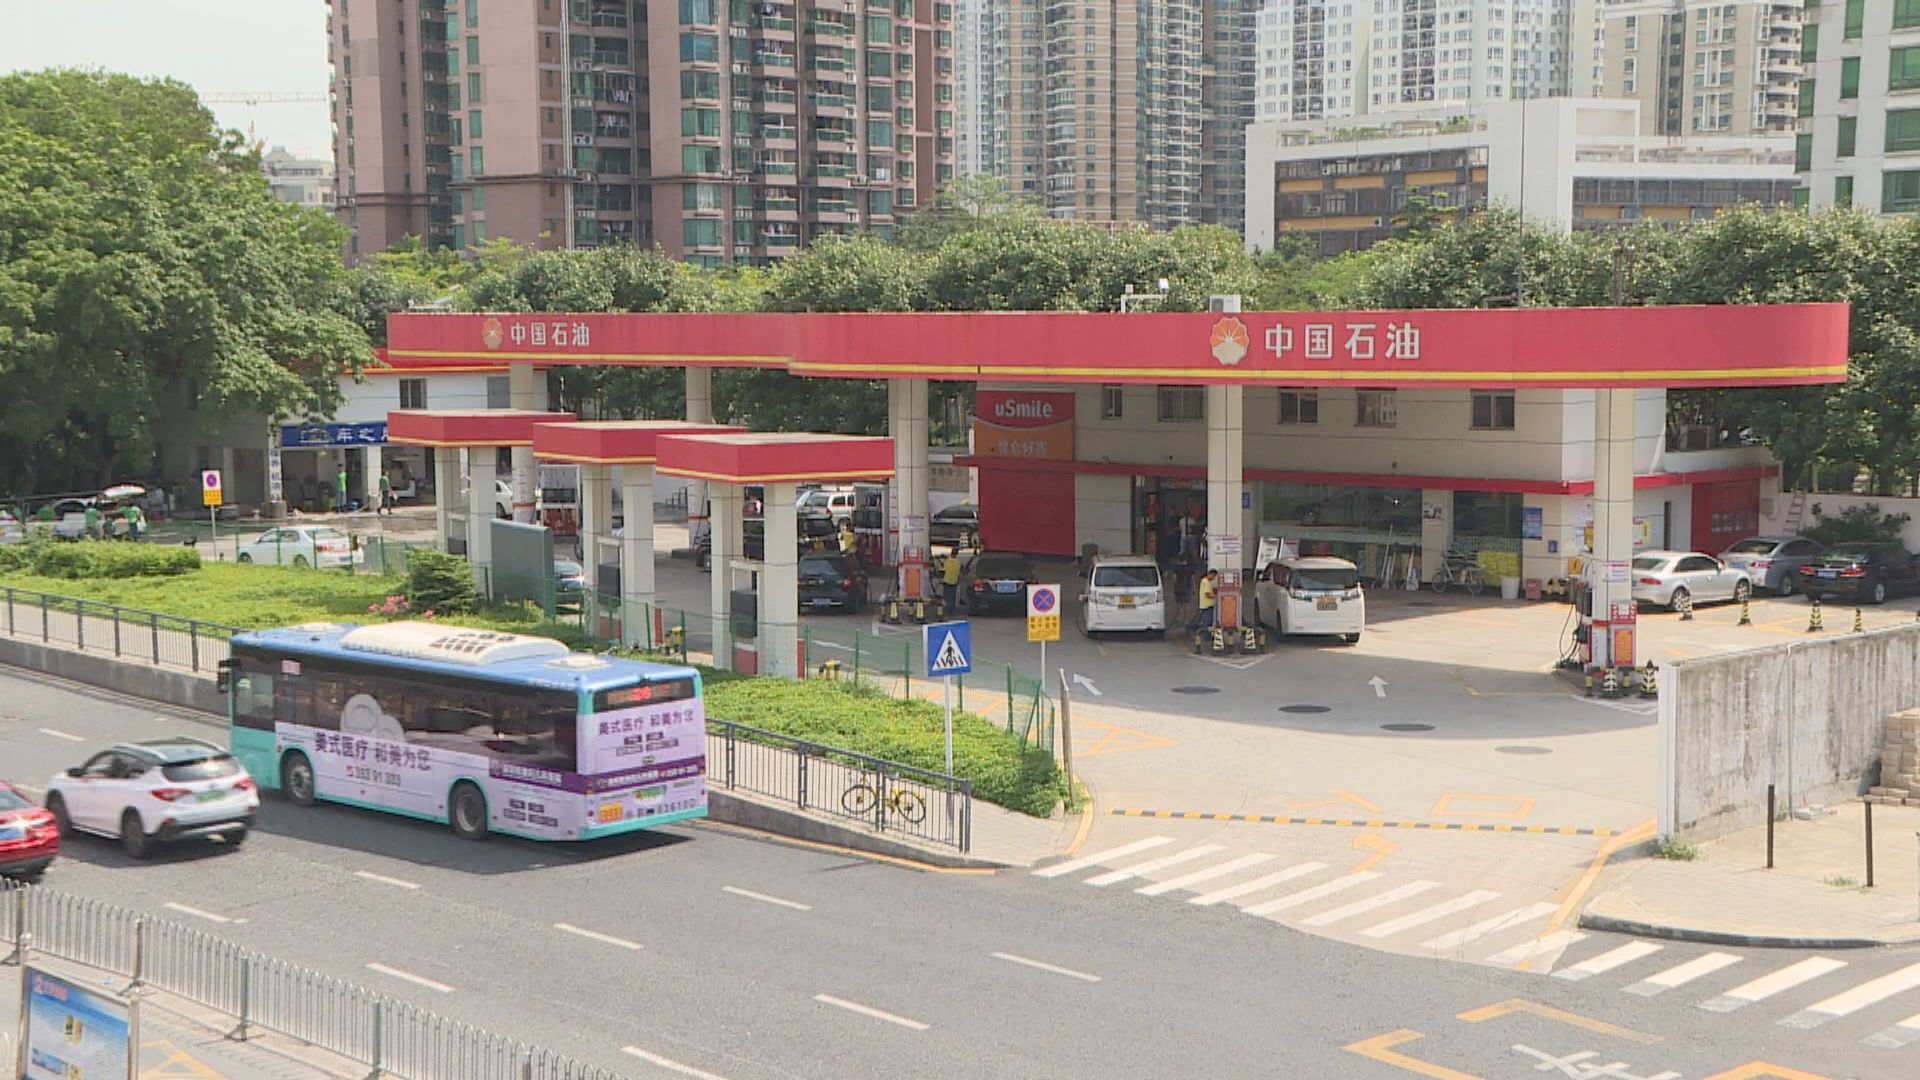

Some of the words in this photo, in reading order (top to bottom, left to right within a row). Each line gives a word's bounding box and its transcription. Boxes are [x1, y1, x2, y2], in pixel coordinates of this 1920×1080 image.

[510, 321, 591, 349] 中国石油
[1264, 322, 1421, 360] 中国石油
[995, 399, 1053, 418] uSmile
[598, 716, 644, 735] 美式医疗
[650, 709, 694, 727] 和美为您
[315, 732, 368, 760] 美式医疗
[375, 742, 431, 771] 和美为您
